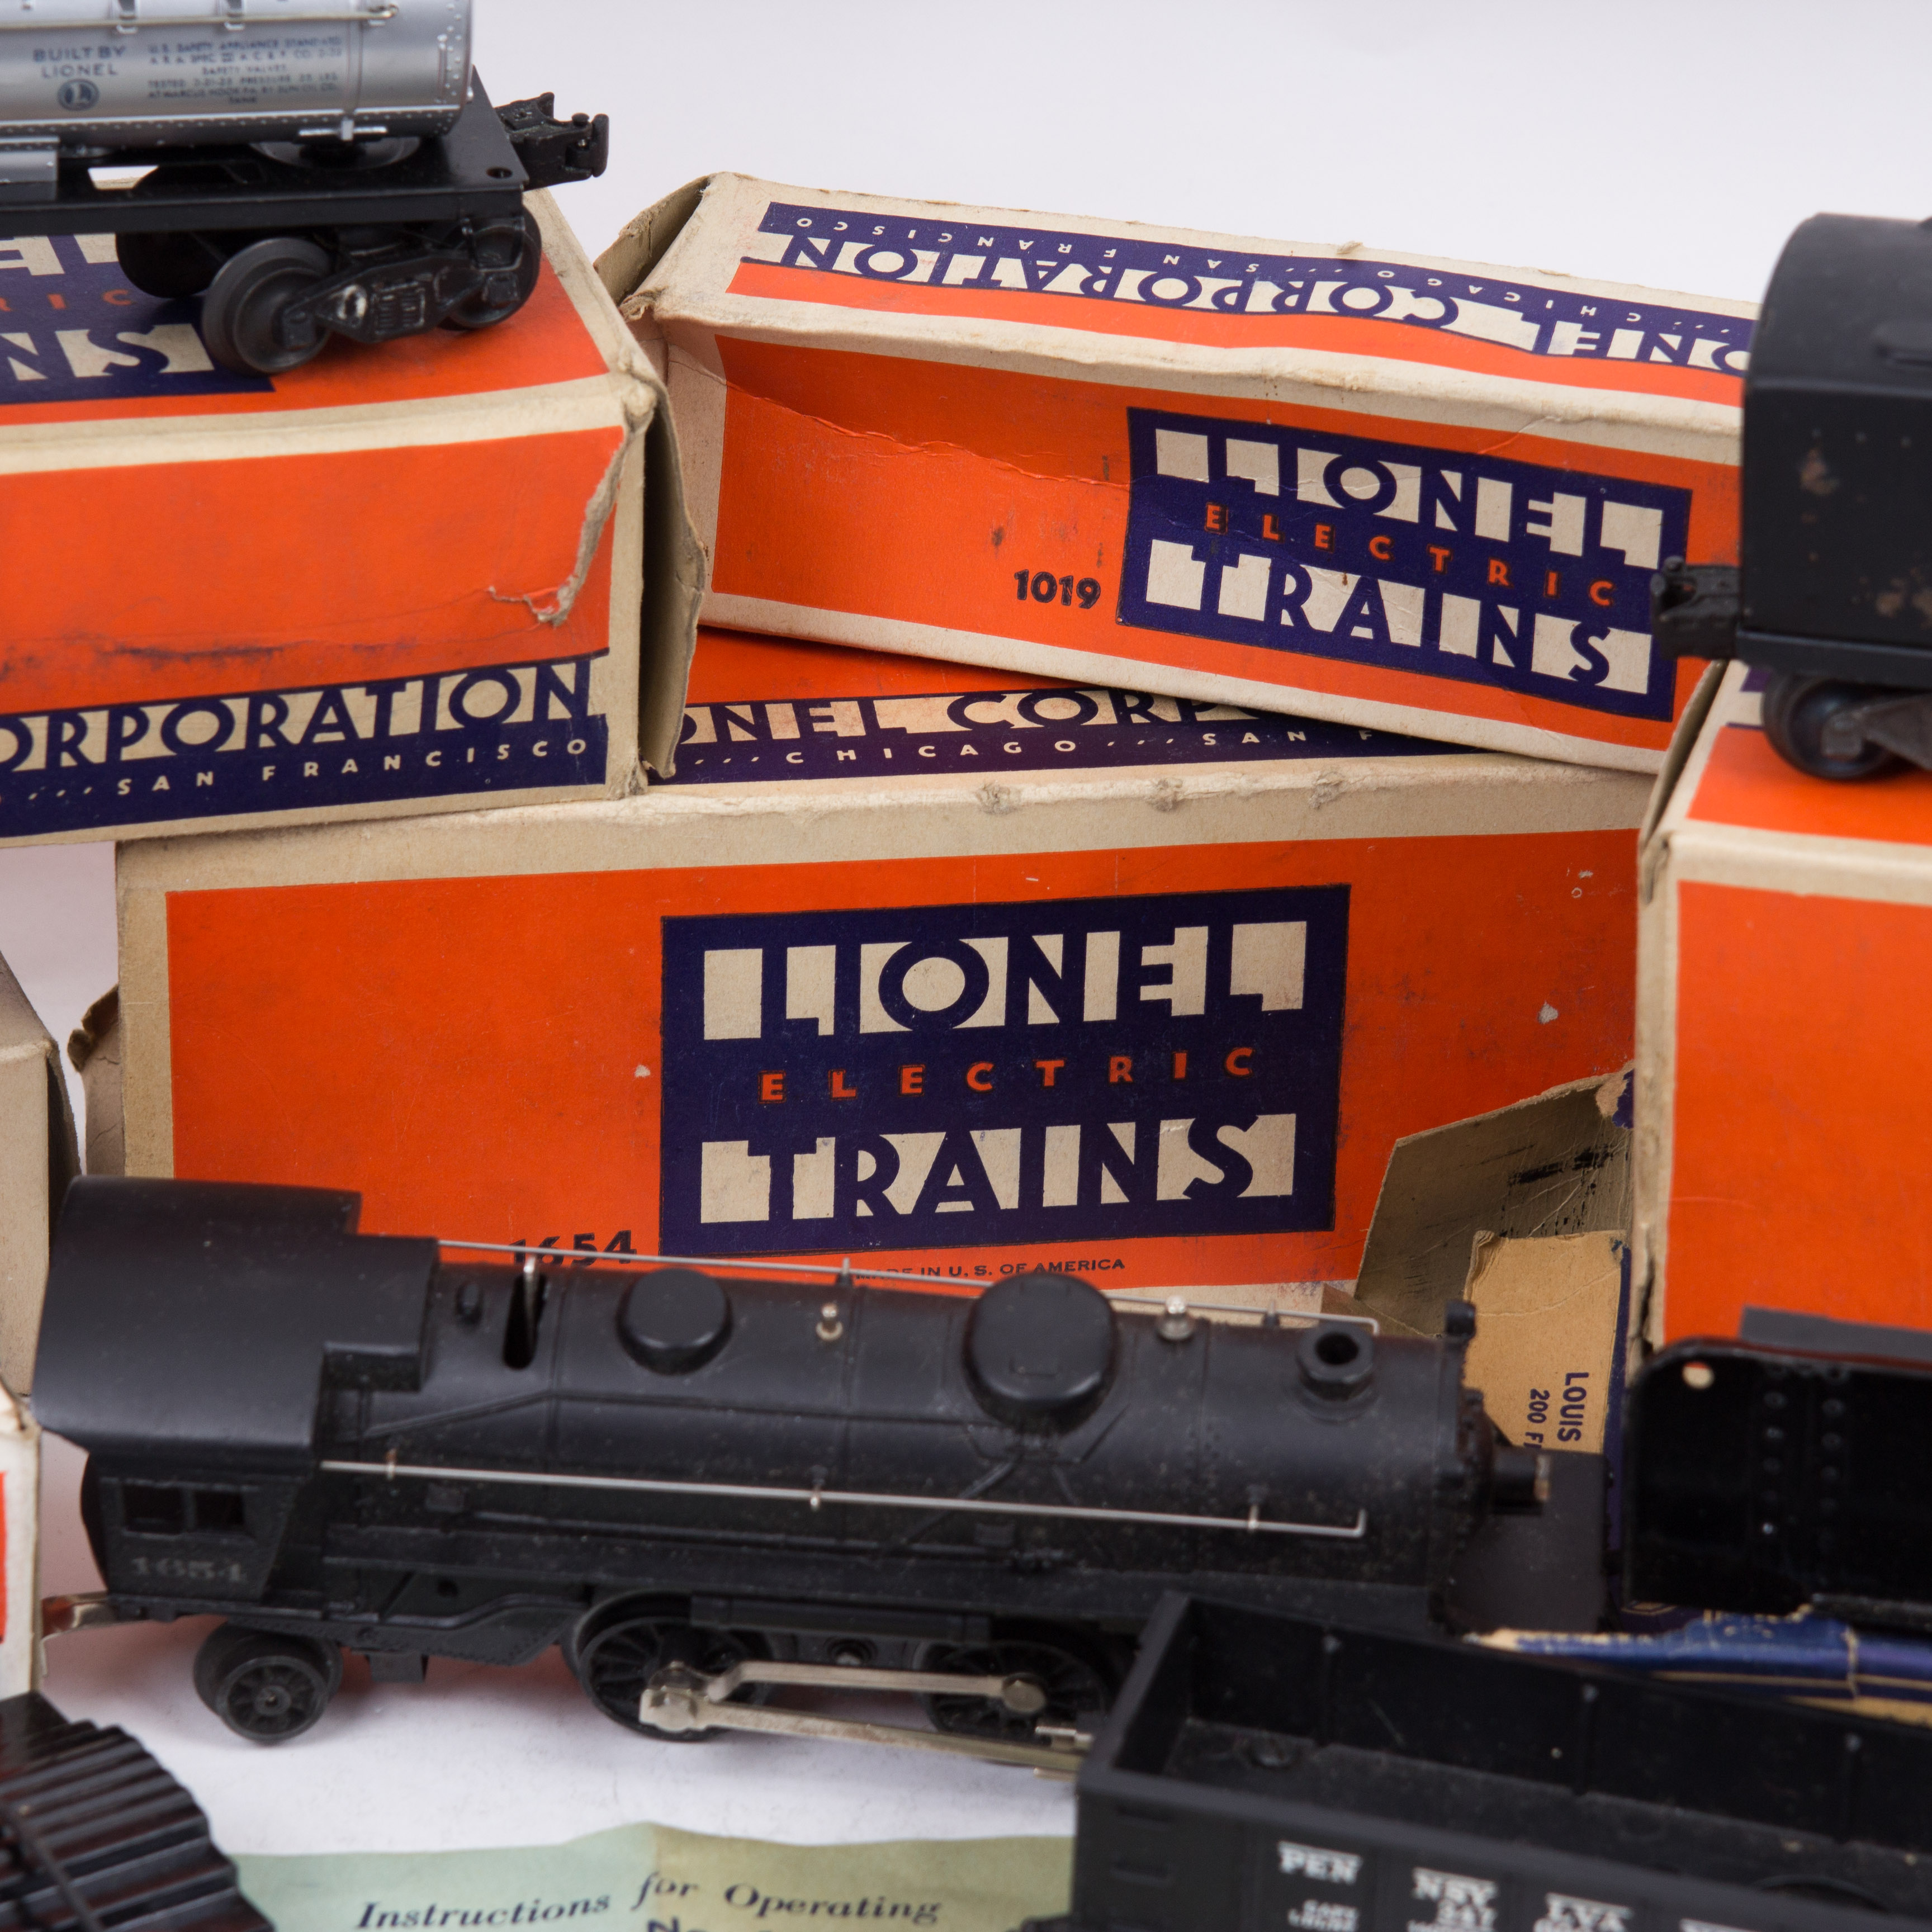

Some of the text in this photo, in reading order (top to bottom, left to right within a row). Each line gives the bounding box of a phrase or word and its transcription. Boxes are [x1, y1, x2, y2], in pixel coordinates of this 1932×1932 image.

[32, 45, 126, 63] BUILT BY
[41, 63, 117, 79] LIONEL
[780, 235, 1459, 331] CORPORATION
[797, 217, 1641, 322] CHICAGO SAN FRANCISCO
[1206, 436, 1627, 568] LIONEL
[1205, 501, 1616, 608] ELECTRIC
[1014, 569, 1101, 609] 1019
[1191, 540, 1612, 685] TRAINS
[117, 738, 586, 796] SAN FRANCISCO
[786, 740, 1077, 764] CHICAGO
[1202, 730, 1307, 745] SAN
[759, 922, 1265, 1040] LIONEL
[758, 1046, 1254, 1103] ELECTRIC
[748, 1116, 1259, 1221] TRAINS
[510, 1230, 637, 1266] 1654
[921, 1267, 940, 1277] IN
[1000, 1263, 1027, 1275] OF
[1035, 1259, 1125, 1273] AMERICA
[1527, 1388, 1550, 1423] 200
[1557, 1372, 1589, 1442] LOUIS
[356, 1871, 942, 1929] Instructions for Operating
